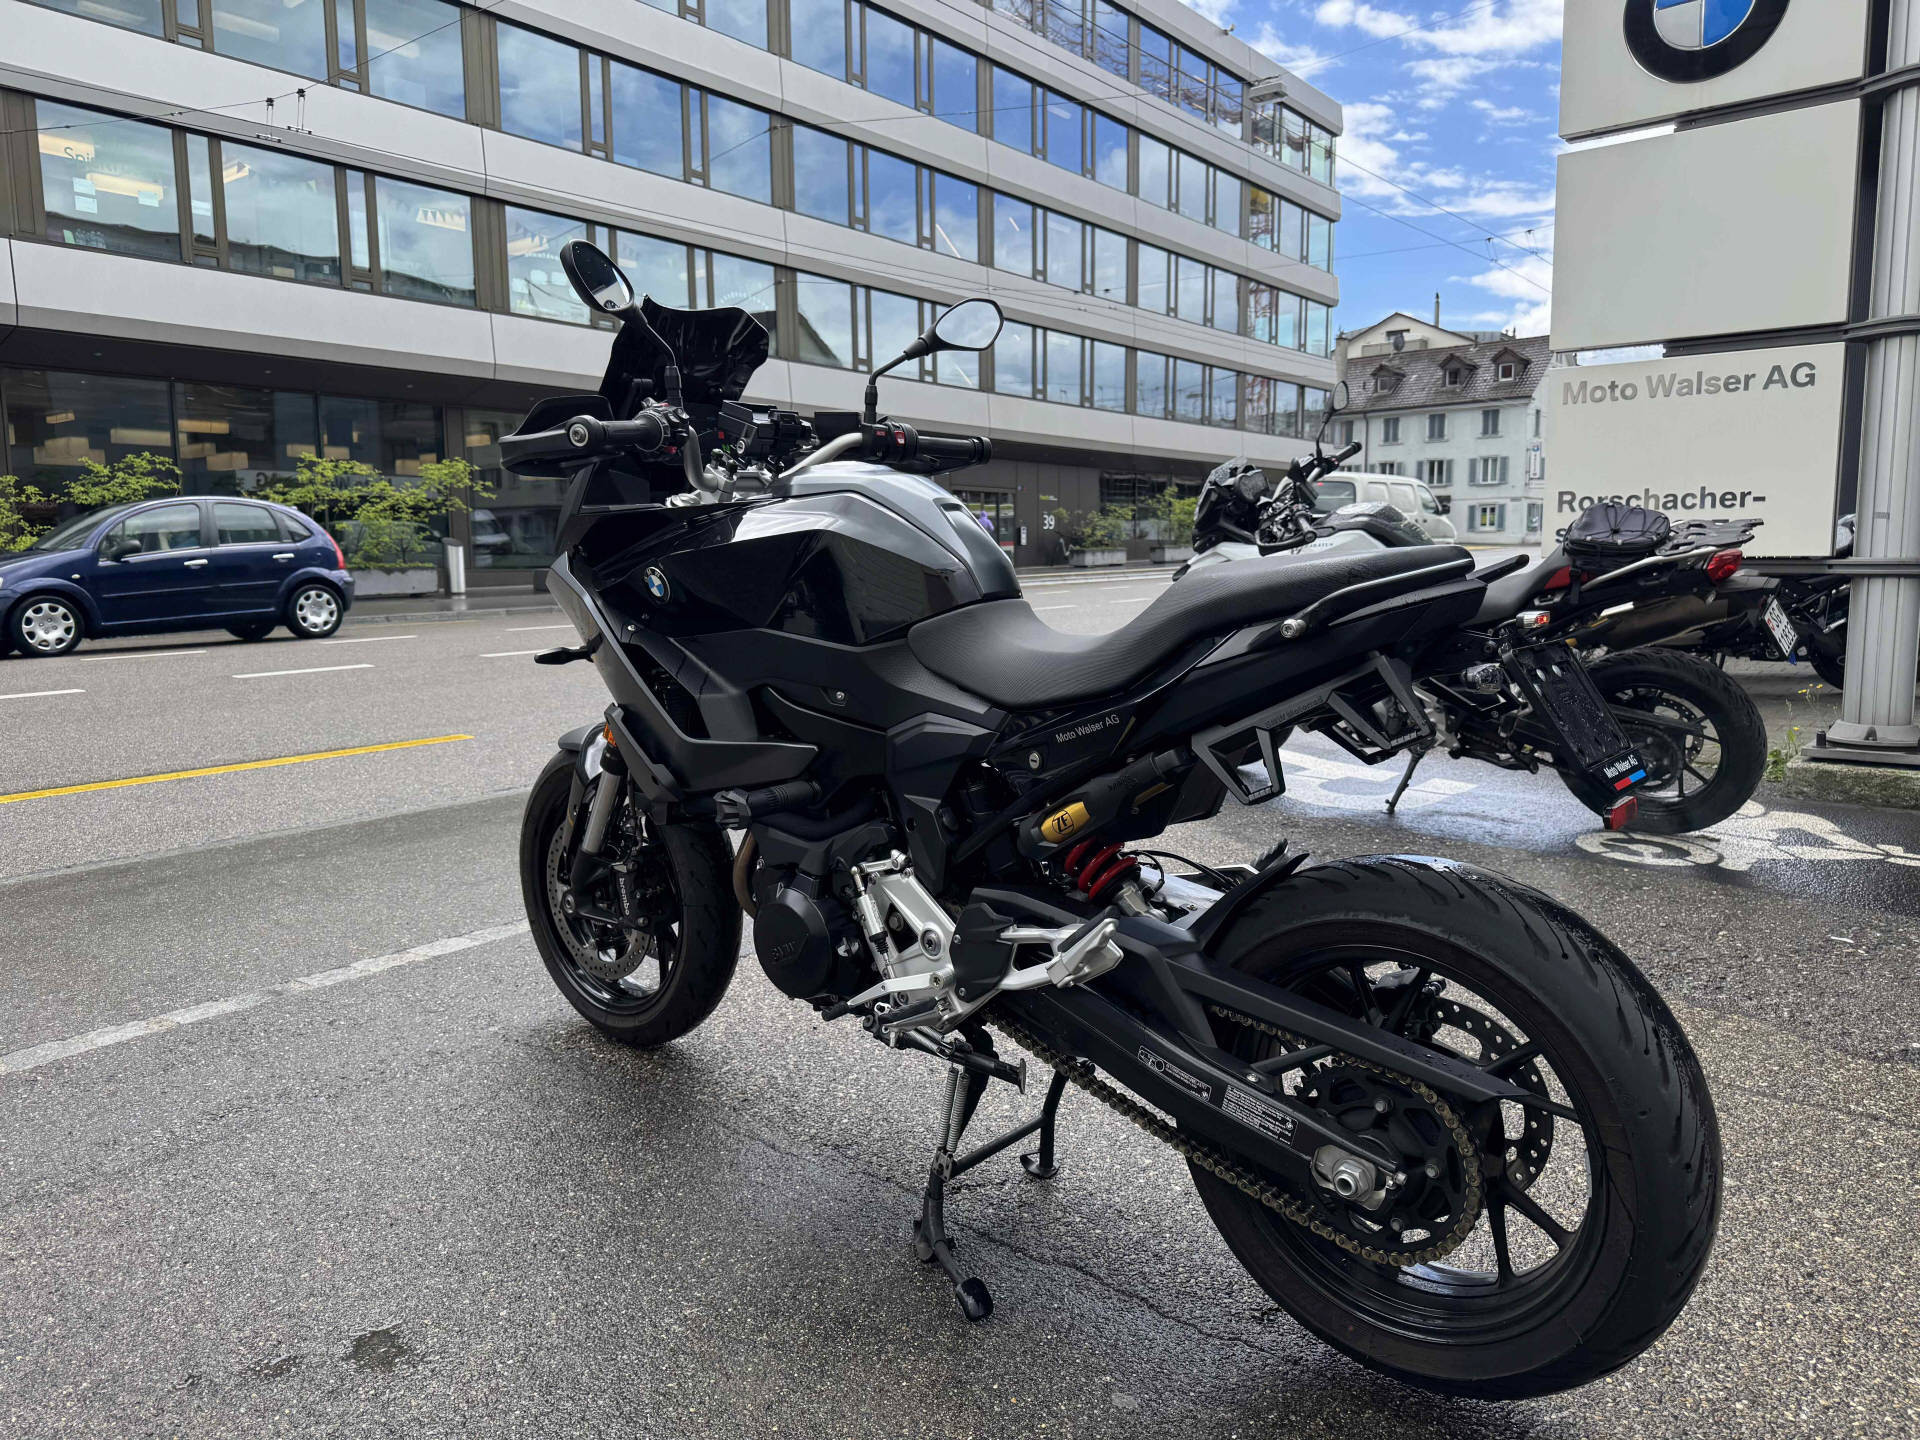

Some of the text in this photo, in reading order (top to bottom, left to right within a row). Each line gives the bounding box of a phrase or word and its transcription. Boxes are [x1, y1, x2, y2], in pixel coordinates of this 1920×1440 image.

[1562, 361, 1817, 405] Moto Walser AG
[1043, 514, 1055, 530] 39
[1055, 714, 1120, 744] Moto Walser AG
[1603, 766, 1619, 779] Moto
[1628, 754, 1639, 767] AG
[619, 877, 630, 916] brembo
